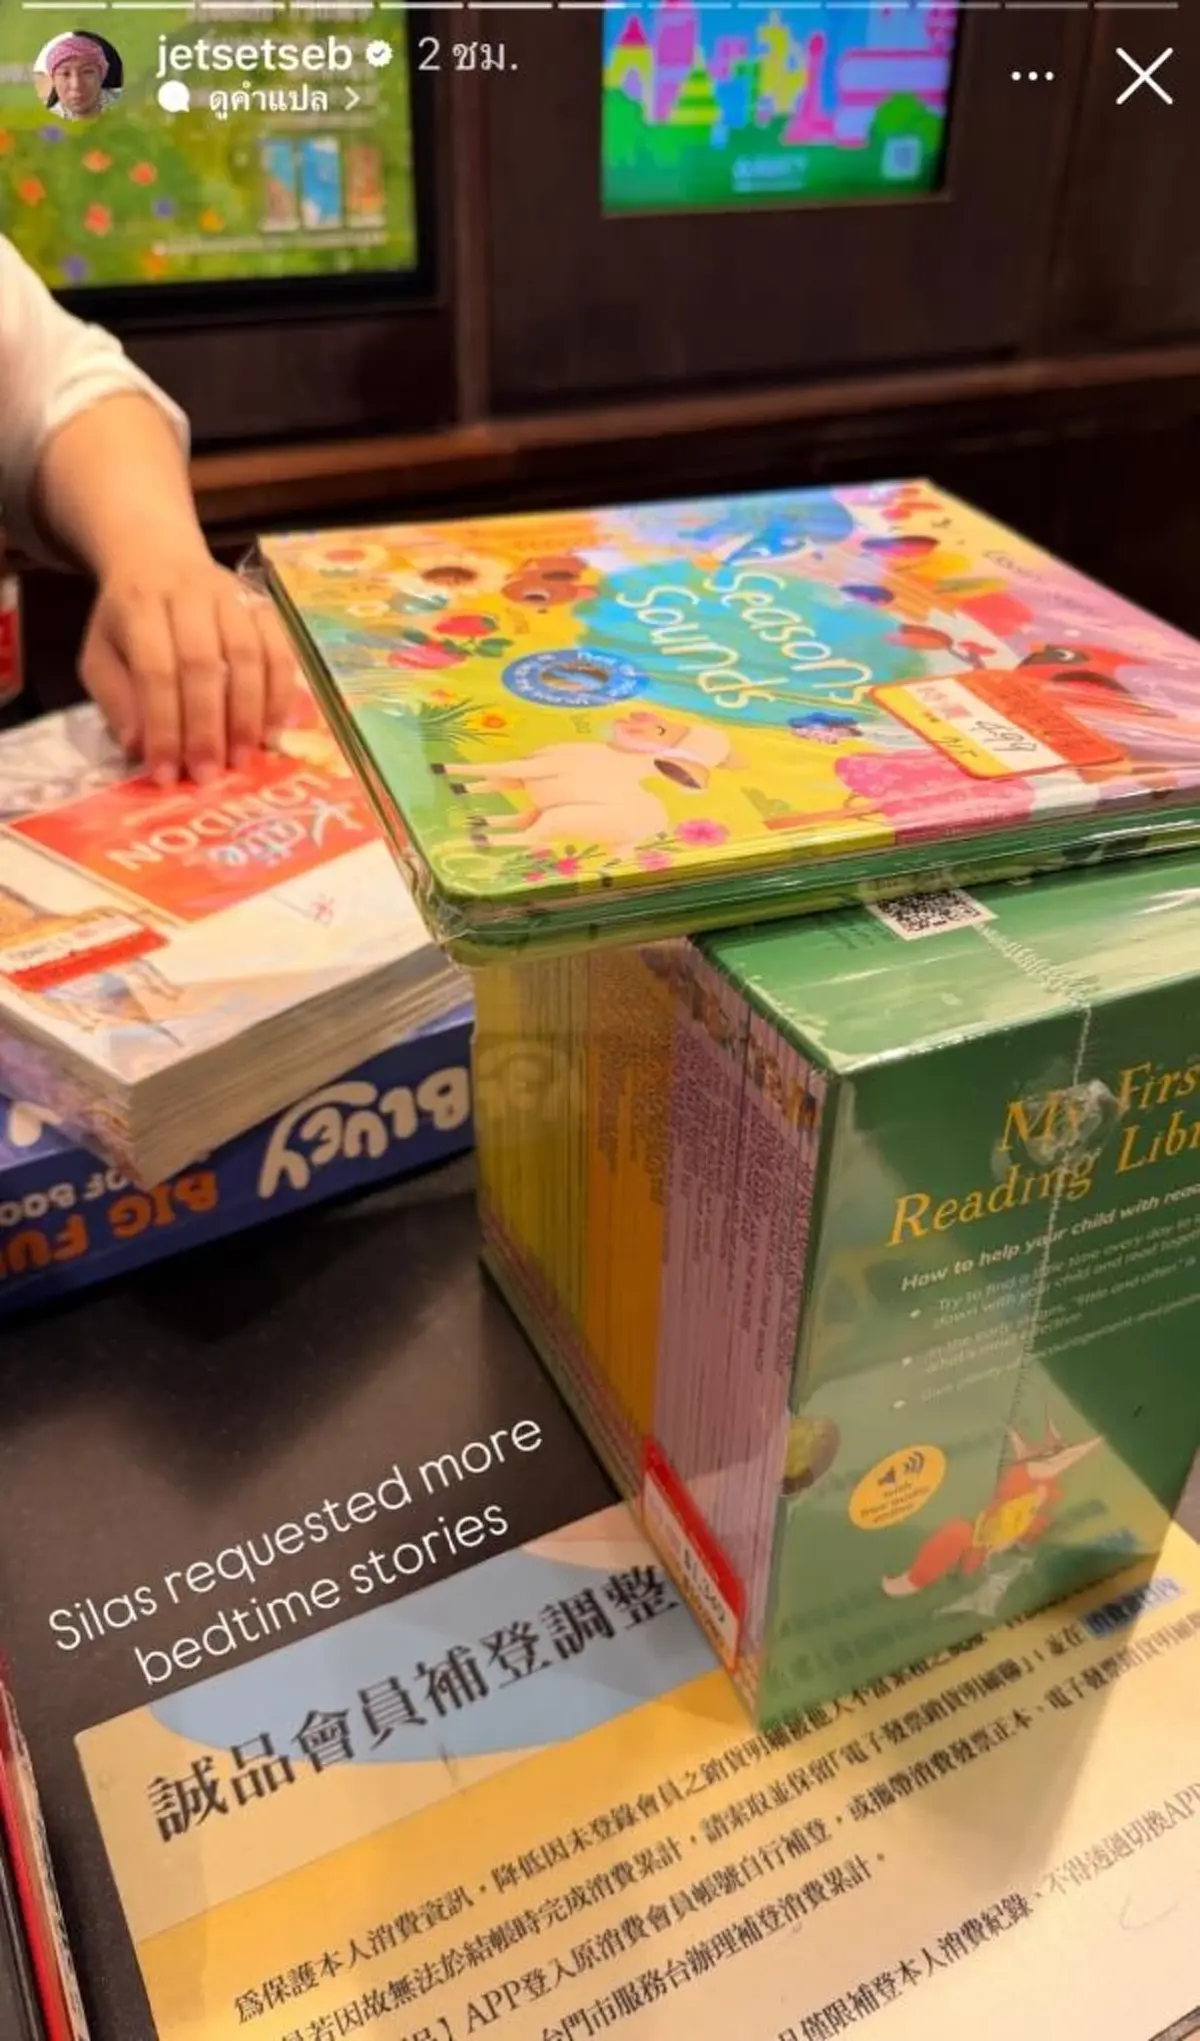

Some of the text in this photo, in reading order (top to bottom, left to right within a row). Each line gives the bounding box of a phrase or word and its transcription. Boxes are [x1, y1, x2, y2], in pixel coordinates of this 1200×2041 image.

[616, 585, 789, 708] Sounds
[106, 770, 331, 871] LONDON
[258, 1066, 471, 1198] BLUEY
[0, 1170, 218, 1279] BIG FU
[884, 1147, 1102, 1248] Reading
[901, 1266, 948, 1293] How
[954, 1259, 974, 1276] to
[979, 1244, 1021, 1268] help
[1071, 1209, 1117, 1238] child
[1119, 1196, 1160, 1221] with
[147, 1564, 680, 1843] 誠品會員補登調整
